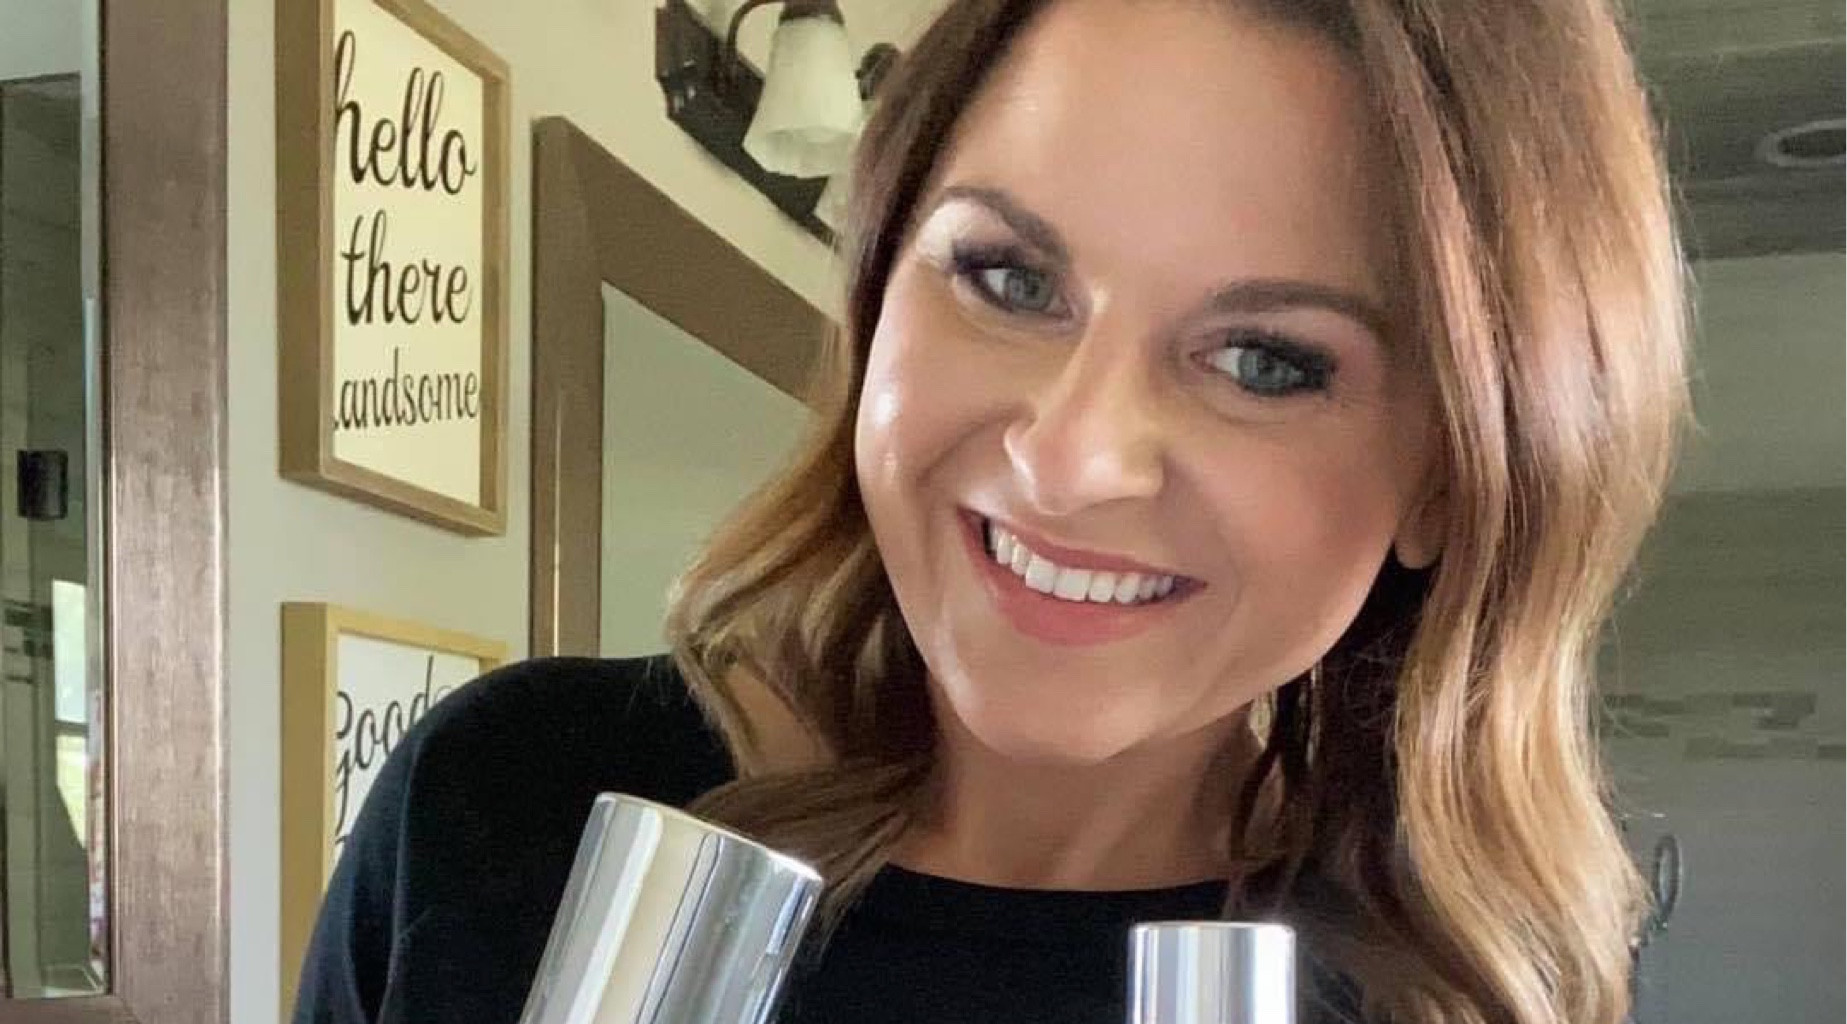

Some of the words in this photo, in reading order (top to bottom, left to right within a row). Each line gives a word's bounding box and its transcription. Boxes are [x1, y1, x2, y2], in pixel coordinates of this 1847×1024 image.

[334, 30, 477, 195] hello
[341, 209, 473, 326] there
[334, 347, 478, 430] andsome
